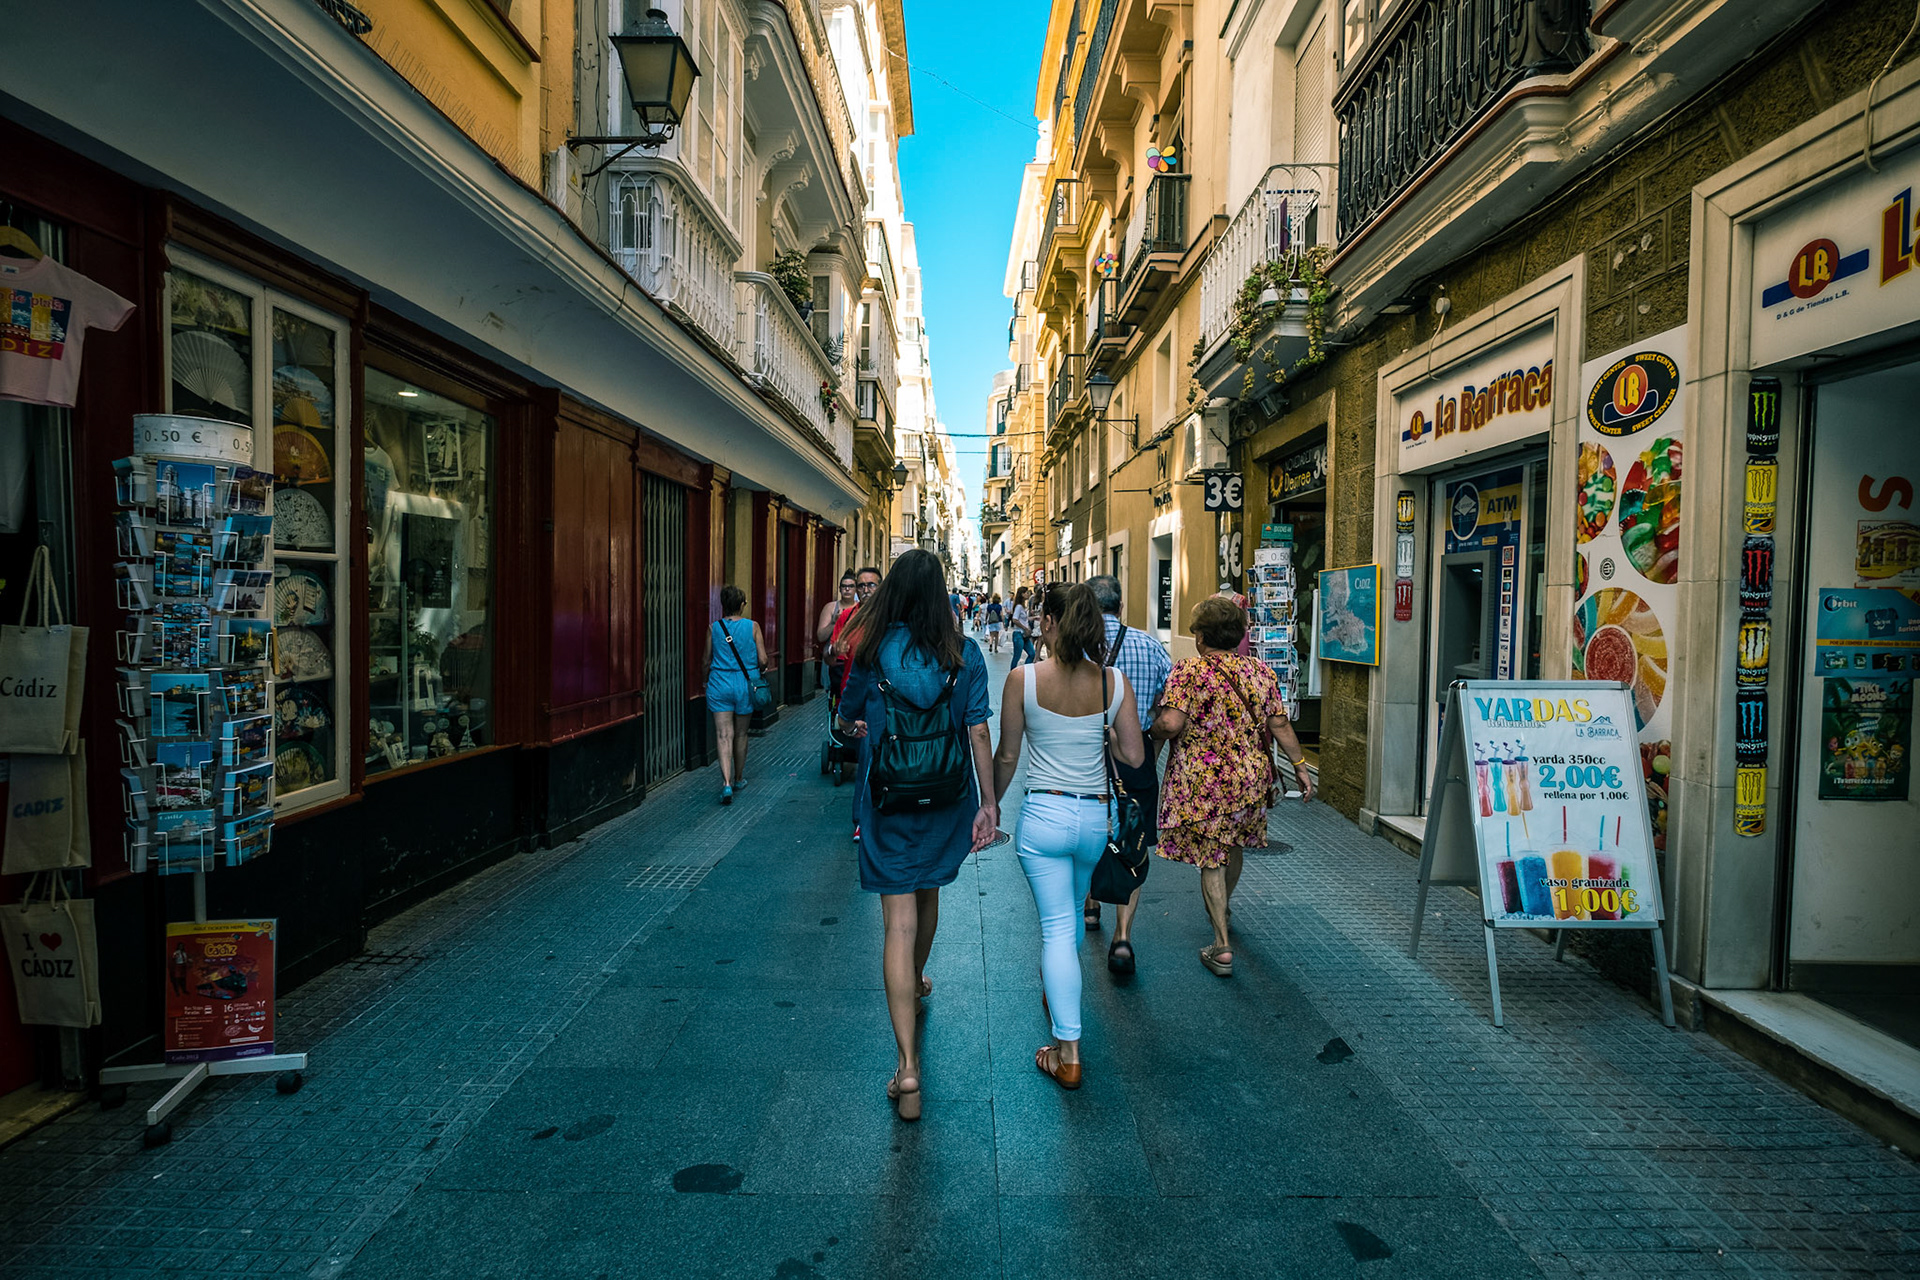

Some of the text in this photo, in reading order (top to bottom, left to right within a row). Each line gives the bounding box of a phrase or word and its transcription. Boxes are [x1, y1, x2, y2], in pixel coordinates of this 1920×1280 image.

[1880, 188, 1920, 288] L
[1635, 353, 1677, 380] SWEET CENTER
[1588, 360, 1627, 406] SWEET CENTER
[1434, 363, 1552, 441] La Barraca
[1631, 388, 1677, 433] SWEET CENTER
[144, 430, 181, 442] 0.50
[1599, 424, 1622, 435] CENTER
[1205, 475, 1243, 509] 3€
[1486, 494, 1517, 515] ATM
[0, 676, 58, 698] Cádiz
[1474, 697, 1593, 723] YARDAS
[1487, 718, 1547, 730] Rellenables
[1532, 754, 1606, 766] yarda 350cc
[1538, 765, 1623, 792] 2,00€
[1543, 791, 1630, 801] rellena por 1,00€
[1539, 876, 1631, 889] vaso granizada
[1554, 888, 1640, 916] 1,00€
[22, 932, 33, 950] I
[21, 952, 75, 978] CÁDIZ
[224, 1003, 234, 1013] 16
